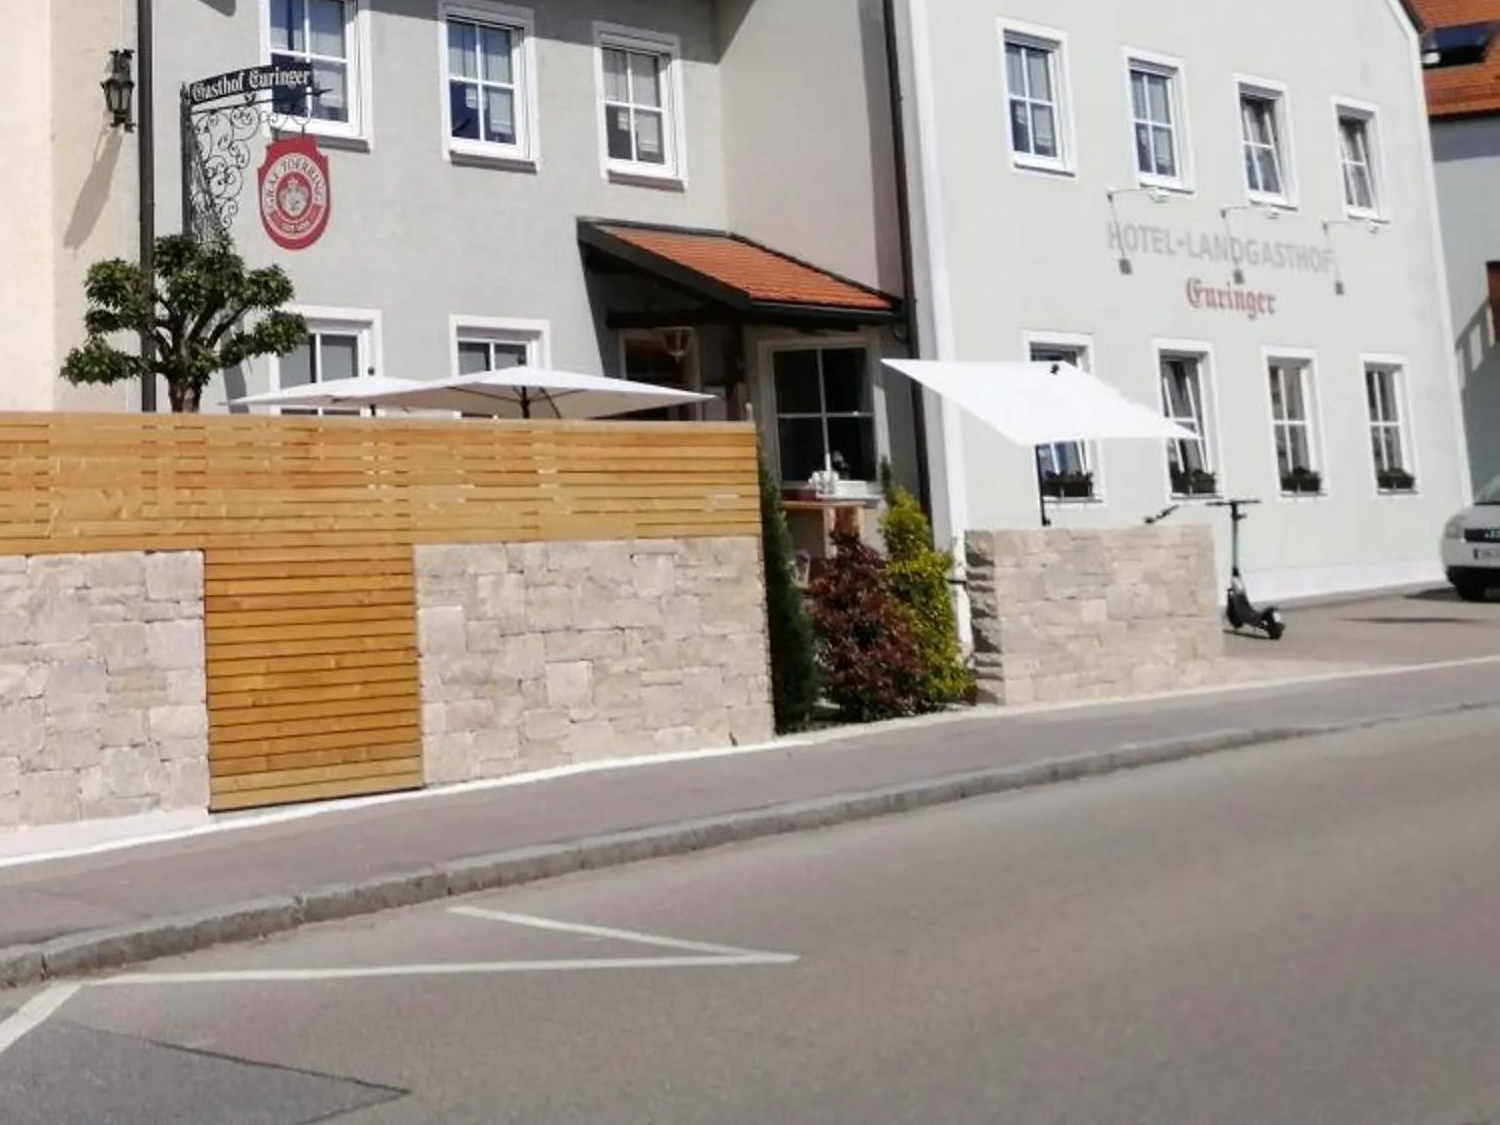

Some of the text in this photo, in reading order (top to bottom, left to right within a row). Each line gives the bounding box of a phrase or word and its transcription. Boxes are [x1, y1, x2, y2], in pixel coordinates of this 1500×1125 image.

[191, 66, 311, 102] Gasthof Euringer
[1107, 222, 1334, 273] HOTEL-LANDGASTHOF
[1186, 277, 1276, 321] Euringer
